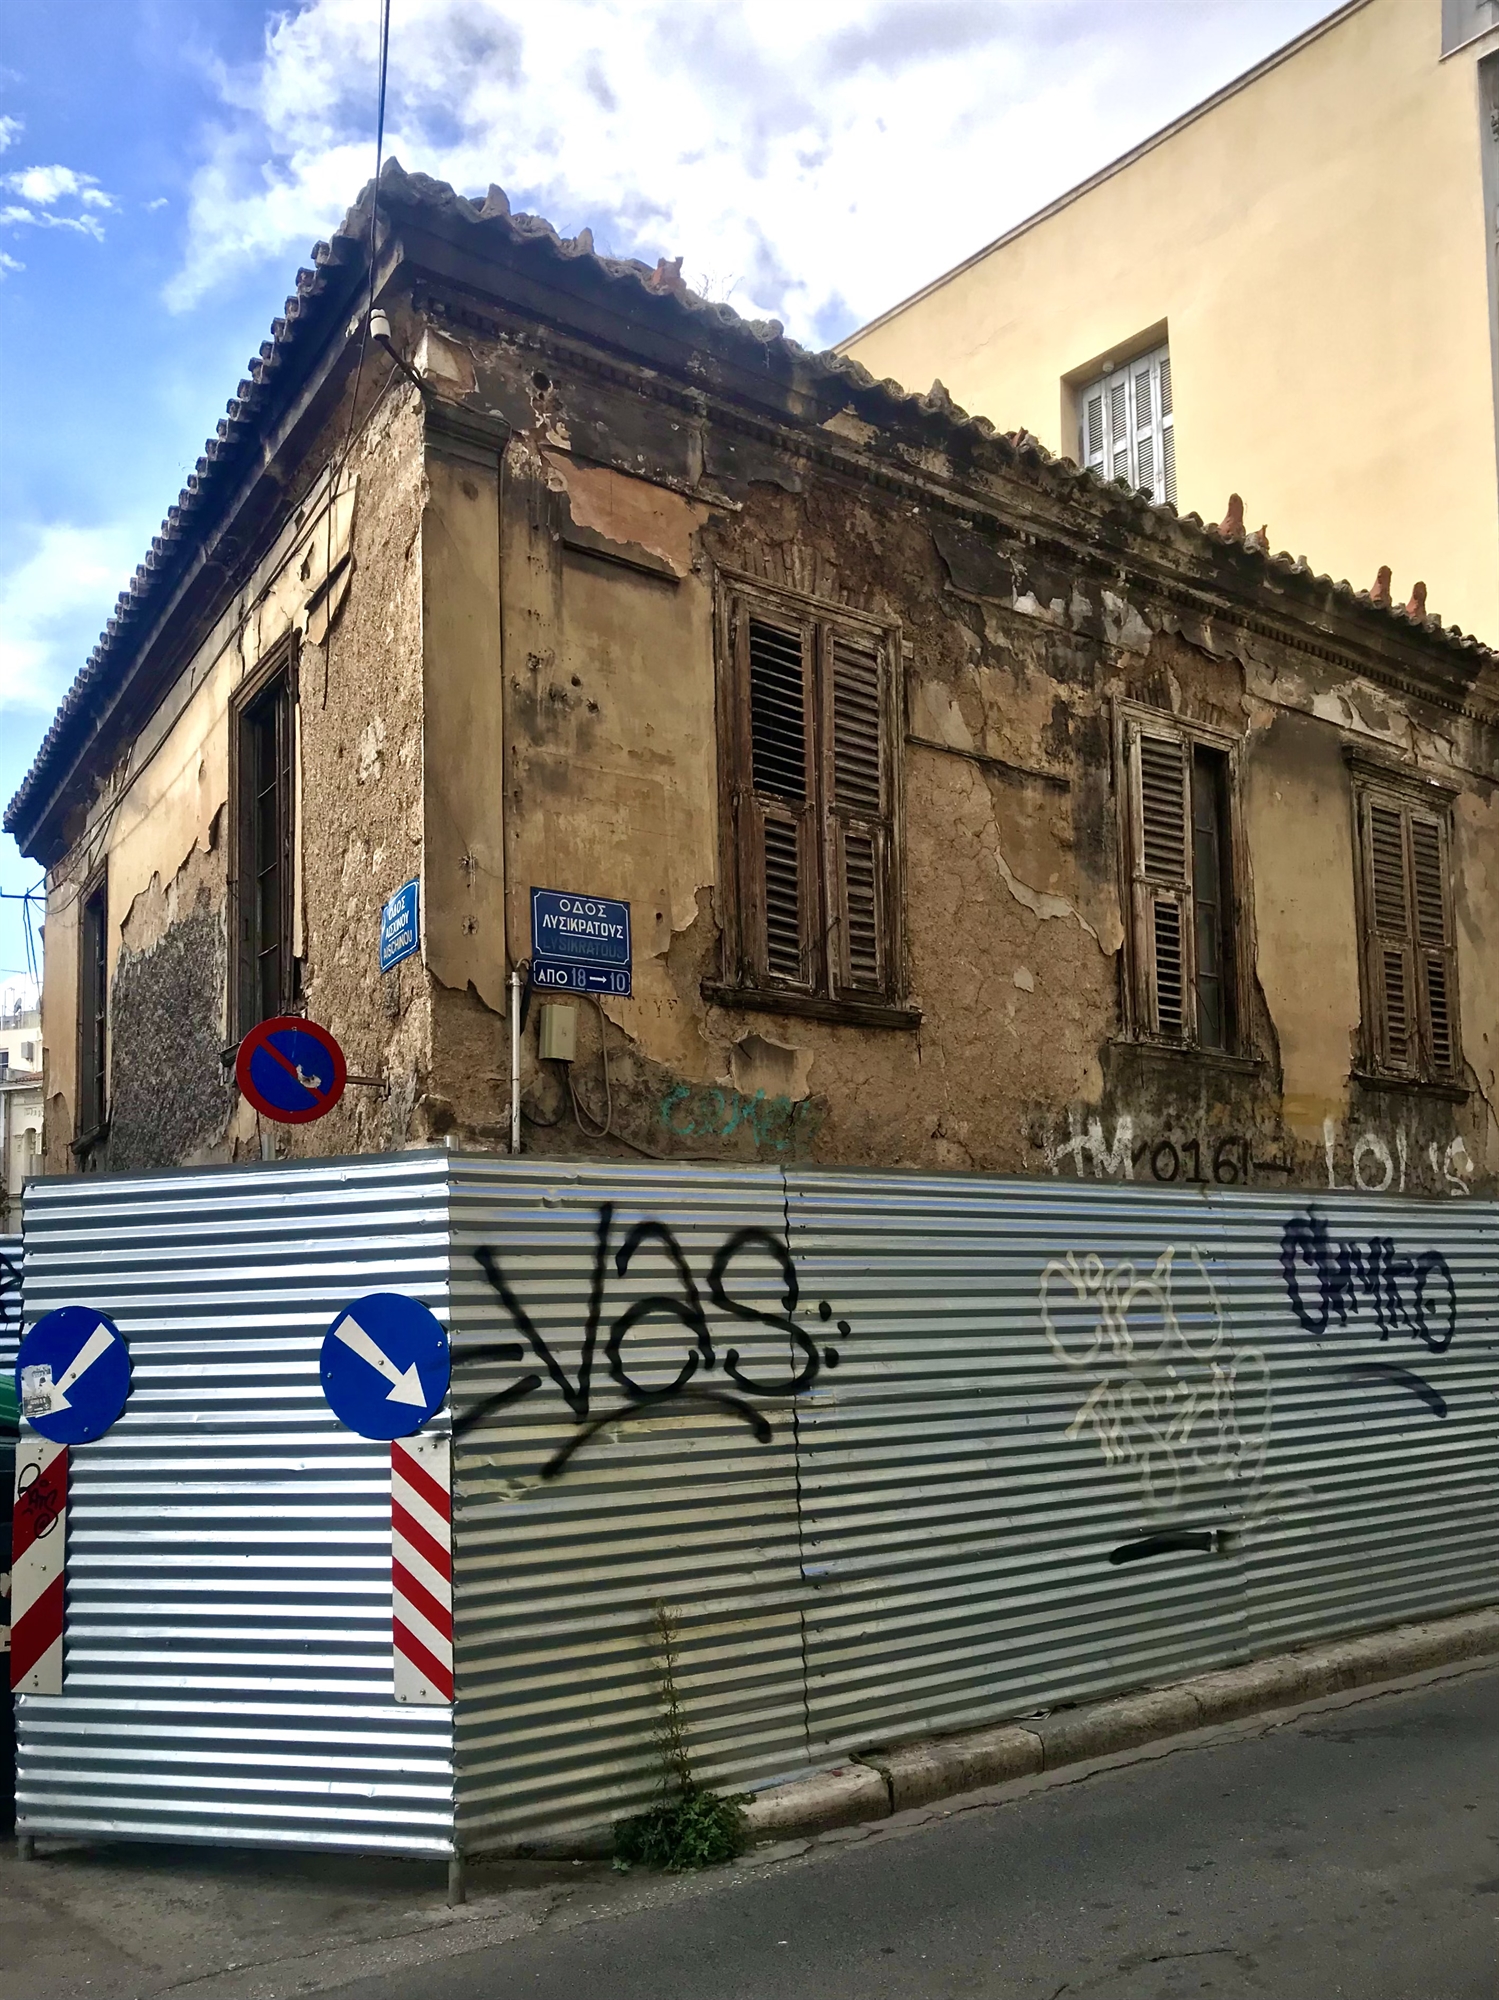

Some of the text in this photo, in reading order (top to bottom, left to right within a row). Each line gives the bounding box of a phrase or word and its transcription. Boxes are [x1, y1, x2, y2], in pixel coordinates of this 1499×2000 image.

[388, 895, 406, 921] ΟΔΟΣ
[559, 899, 607, 918] ΟΔΟΣ
[542, 913, 624, 939] ΛΥΣΙΚΡΑΤΟΥΣ
[542, 936, 624, 960] LYSIKRATOUS
[538, 967, 626, 991] ΑΠΟ 18 10
